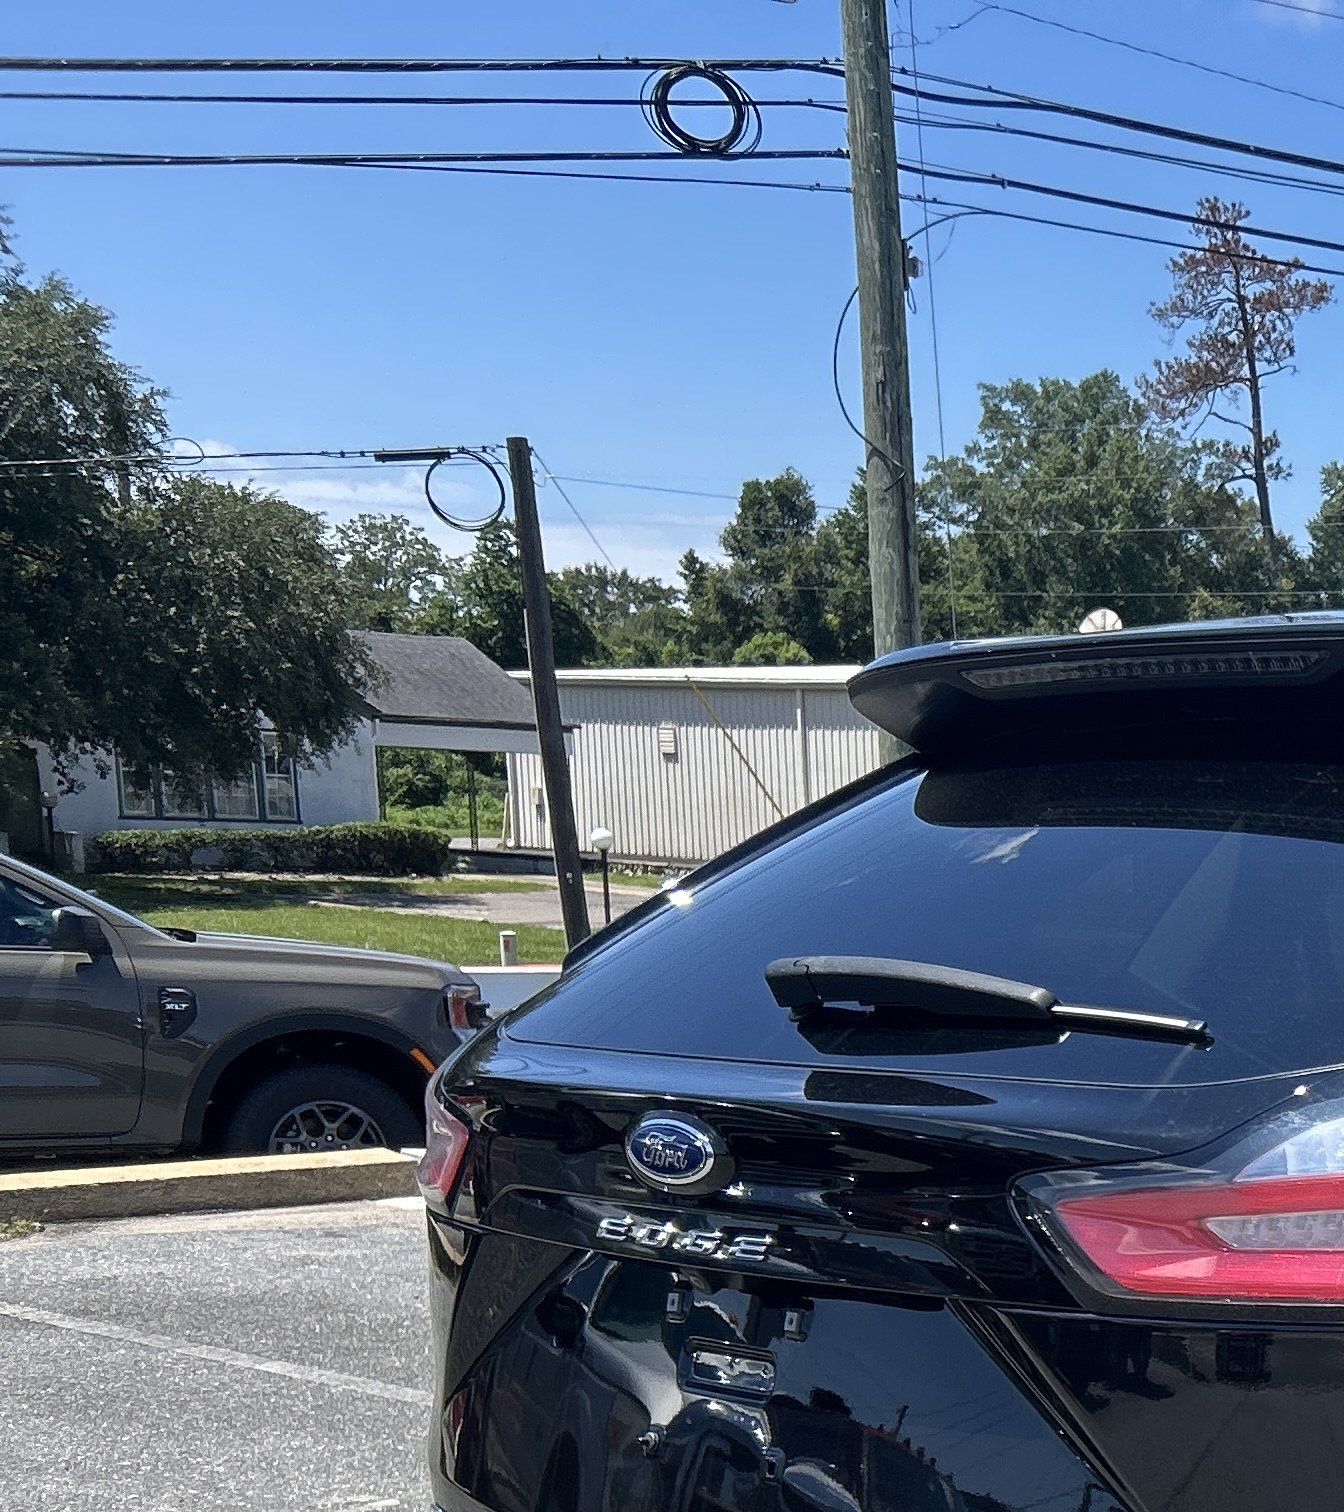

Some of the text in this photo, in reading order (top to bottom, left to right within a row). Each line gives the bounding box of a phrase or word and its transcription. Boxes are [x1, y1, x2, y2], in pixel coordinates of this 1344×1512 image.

[164, 1003, 190, 1011] XLT
[636, 1131, 693, 1170] Ford
[596, 1213, 775, 1261] EDGE
